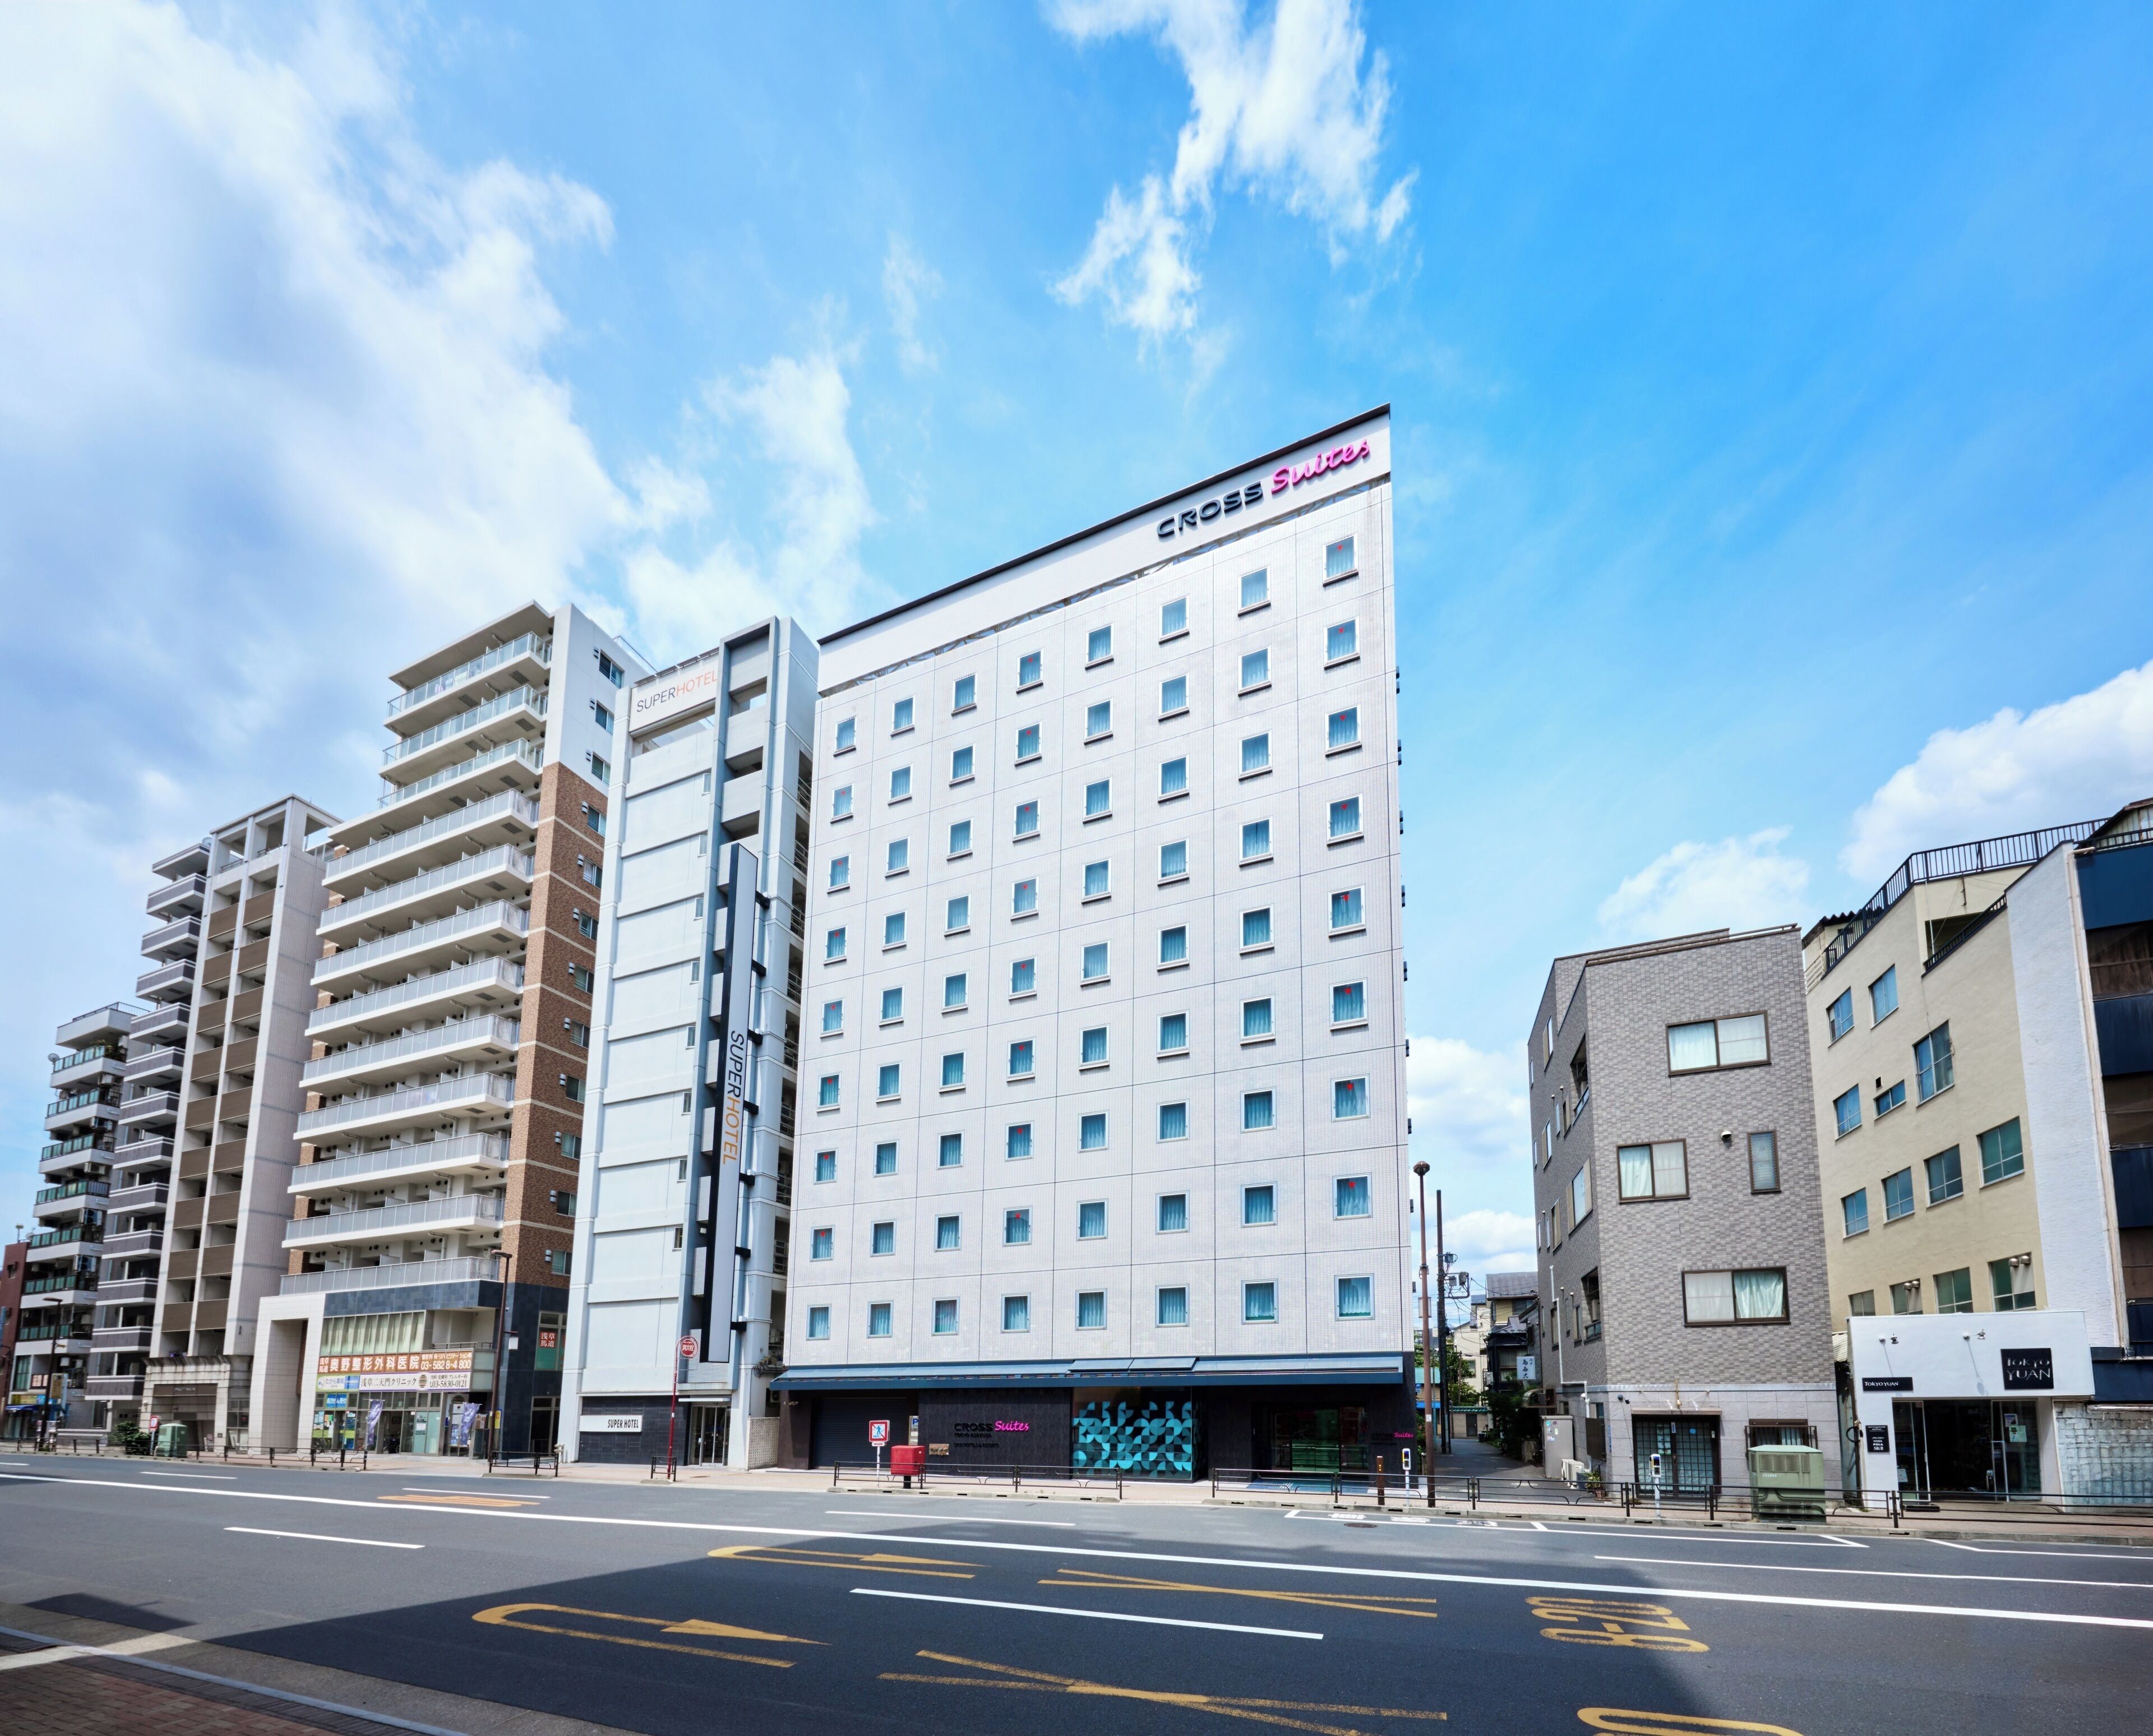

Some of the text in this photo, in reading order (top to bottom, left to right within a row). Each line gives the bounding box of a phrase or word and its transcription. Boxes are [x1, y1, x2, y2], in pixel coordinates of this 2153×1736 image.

[1156, 438, 1370, 537] CROSS Suites
[330, 1355, 420, 1372] 奥野整形外科医院
[421, 1359, 472, 1370] 03-5828-4800
[2006, 1357, 2050, 1368] TOKYO
[2006, 1368, 2050, 1381] YUAN
[361, 1377, 417, 1387] 浅草二天門クリニック
[608, 1419, 639, 1428] SUPER HOTEL
[954, 1420, 1029, 1431] CROSS Suites
